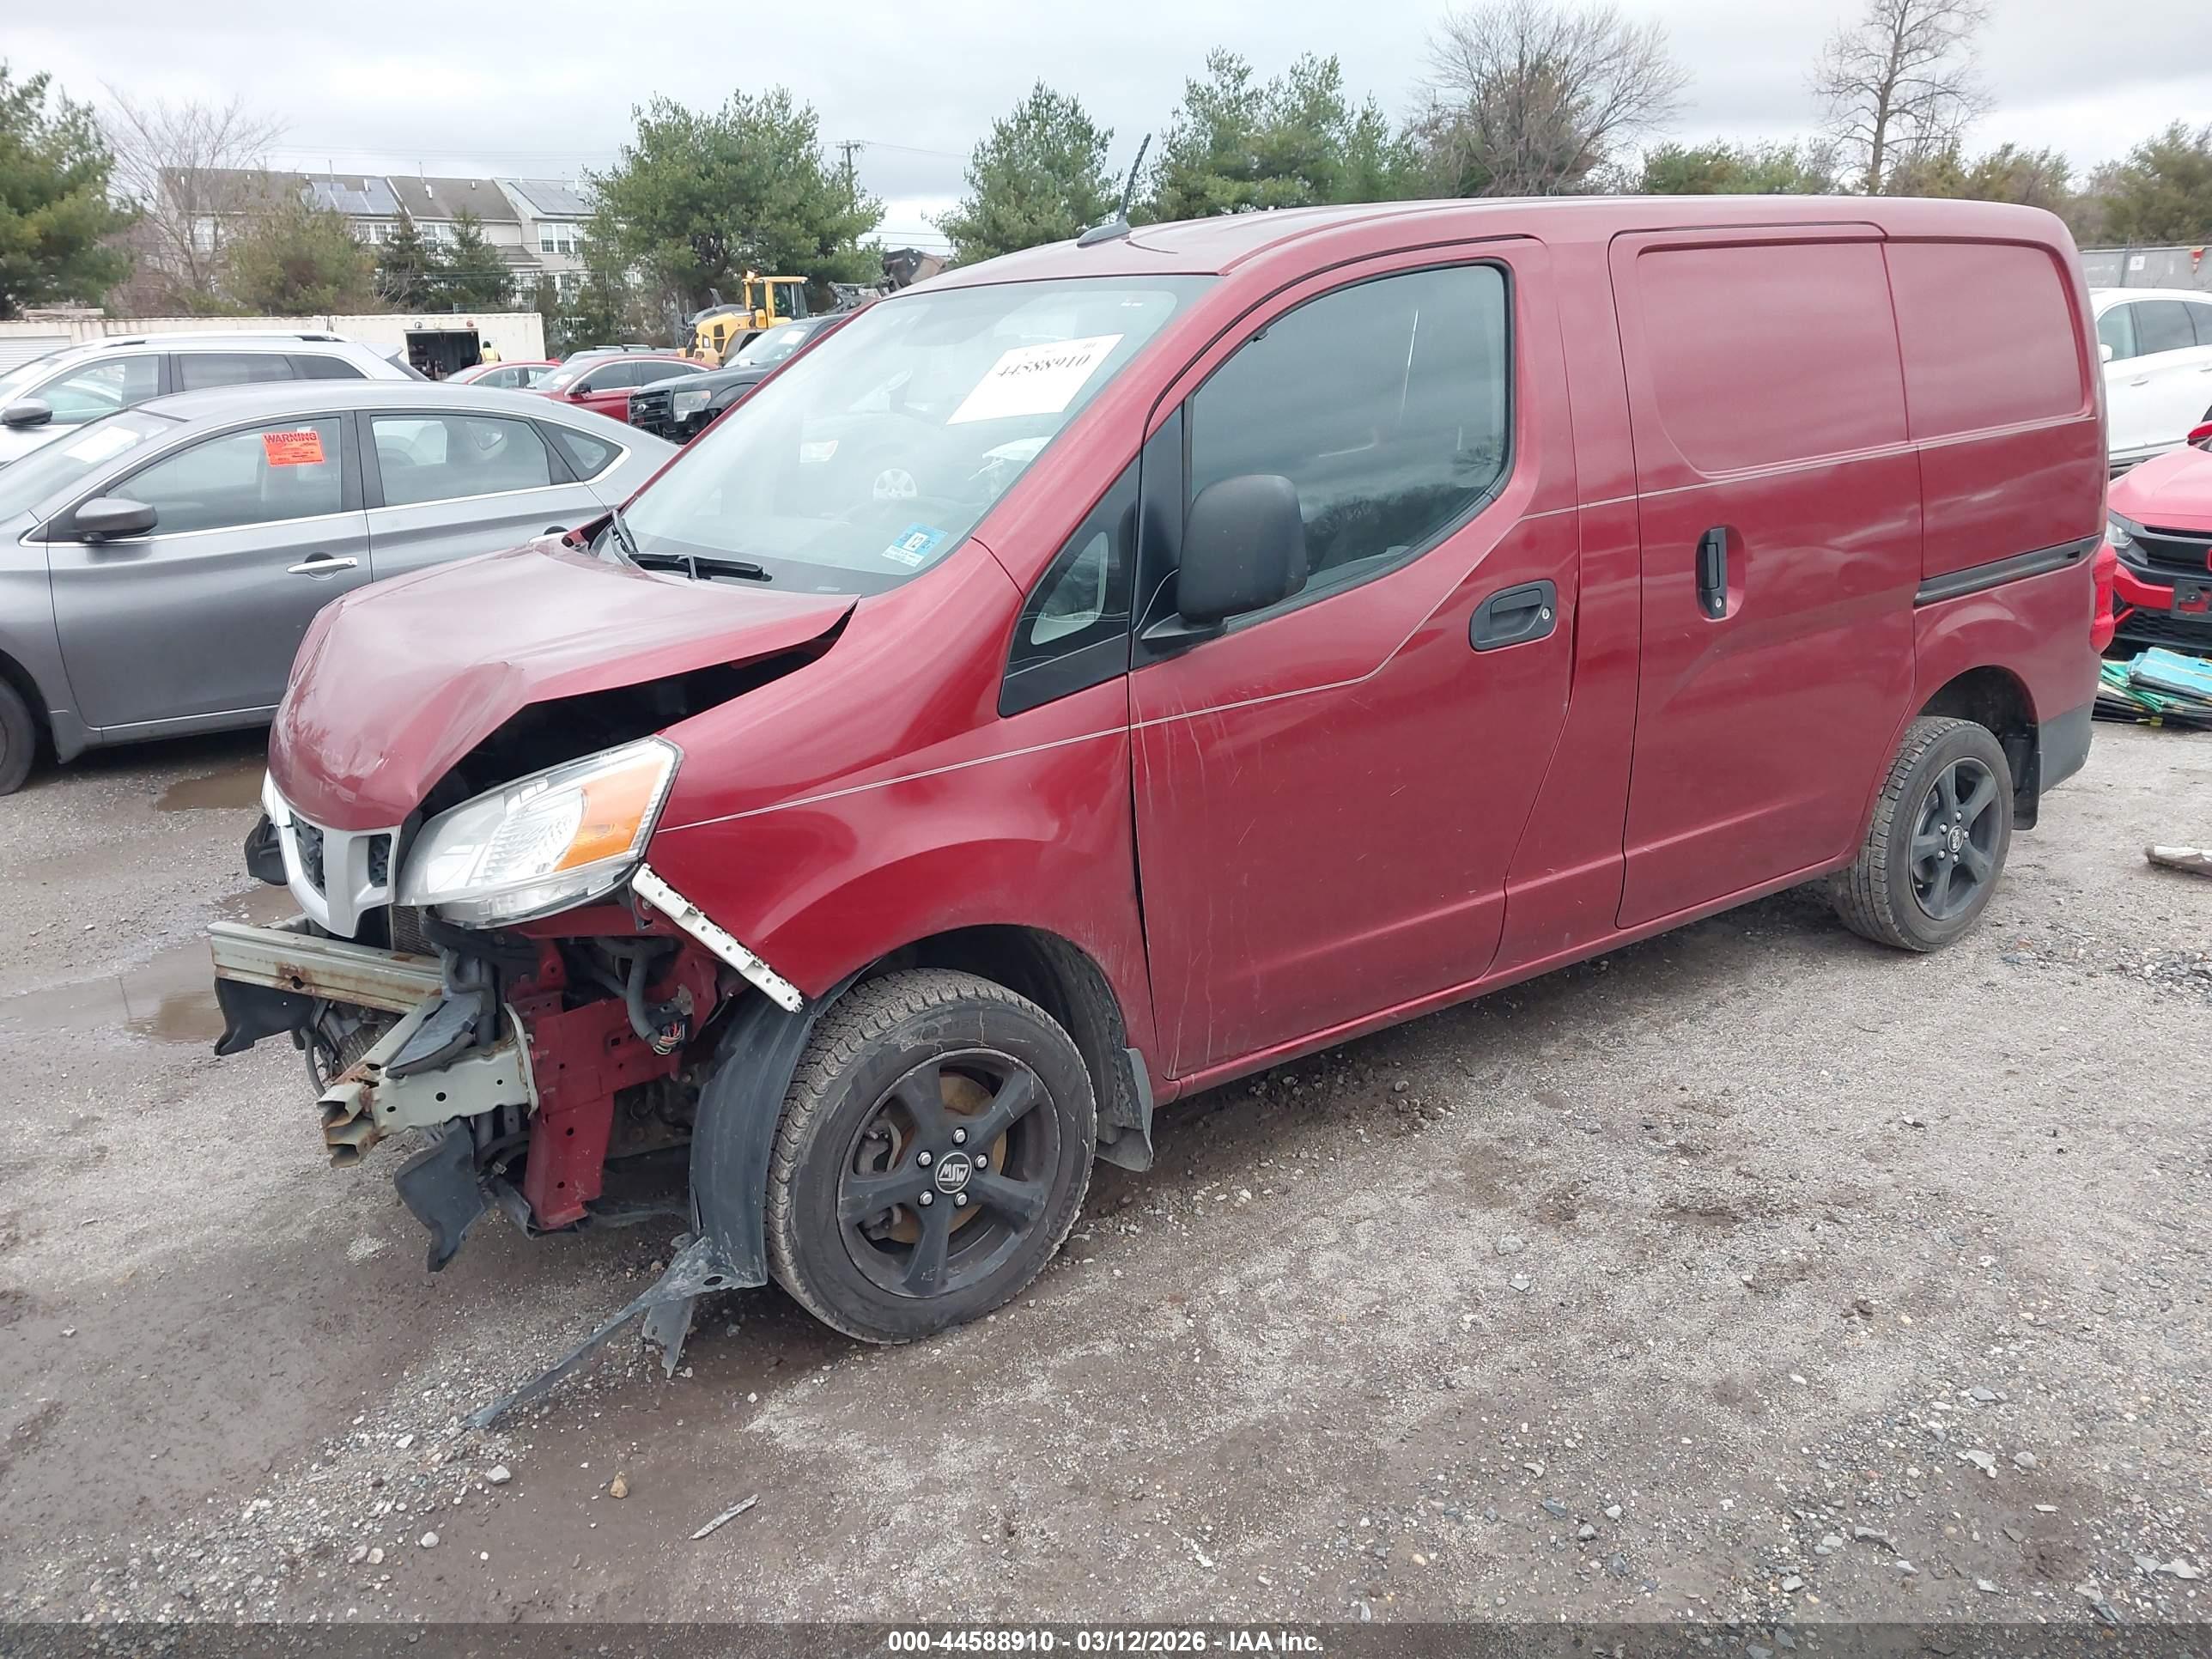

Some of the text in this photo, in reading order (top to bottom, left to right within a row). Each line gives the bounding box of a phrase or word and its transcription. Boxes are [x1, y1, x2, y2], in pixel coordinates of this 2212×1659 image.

[997, 354, 1091, 378] 44588910
[264, 432, 317, 443] WARNING
[908, 535, 924, 549] 12
[939, 1164, 969, 1182] MSW
